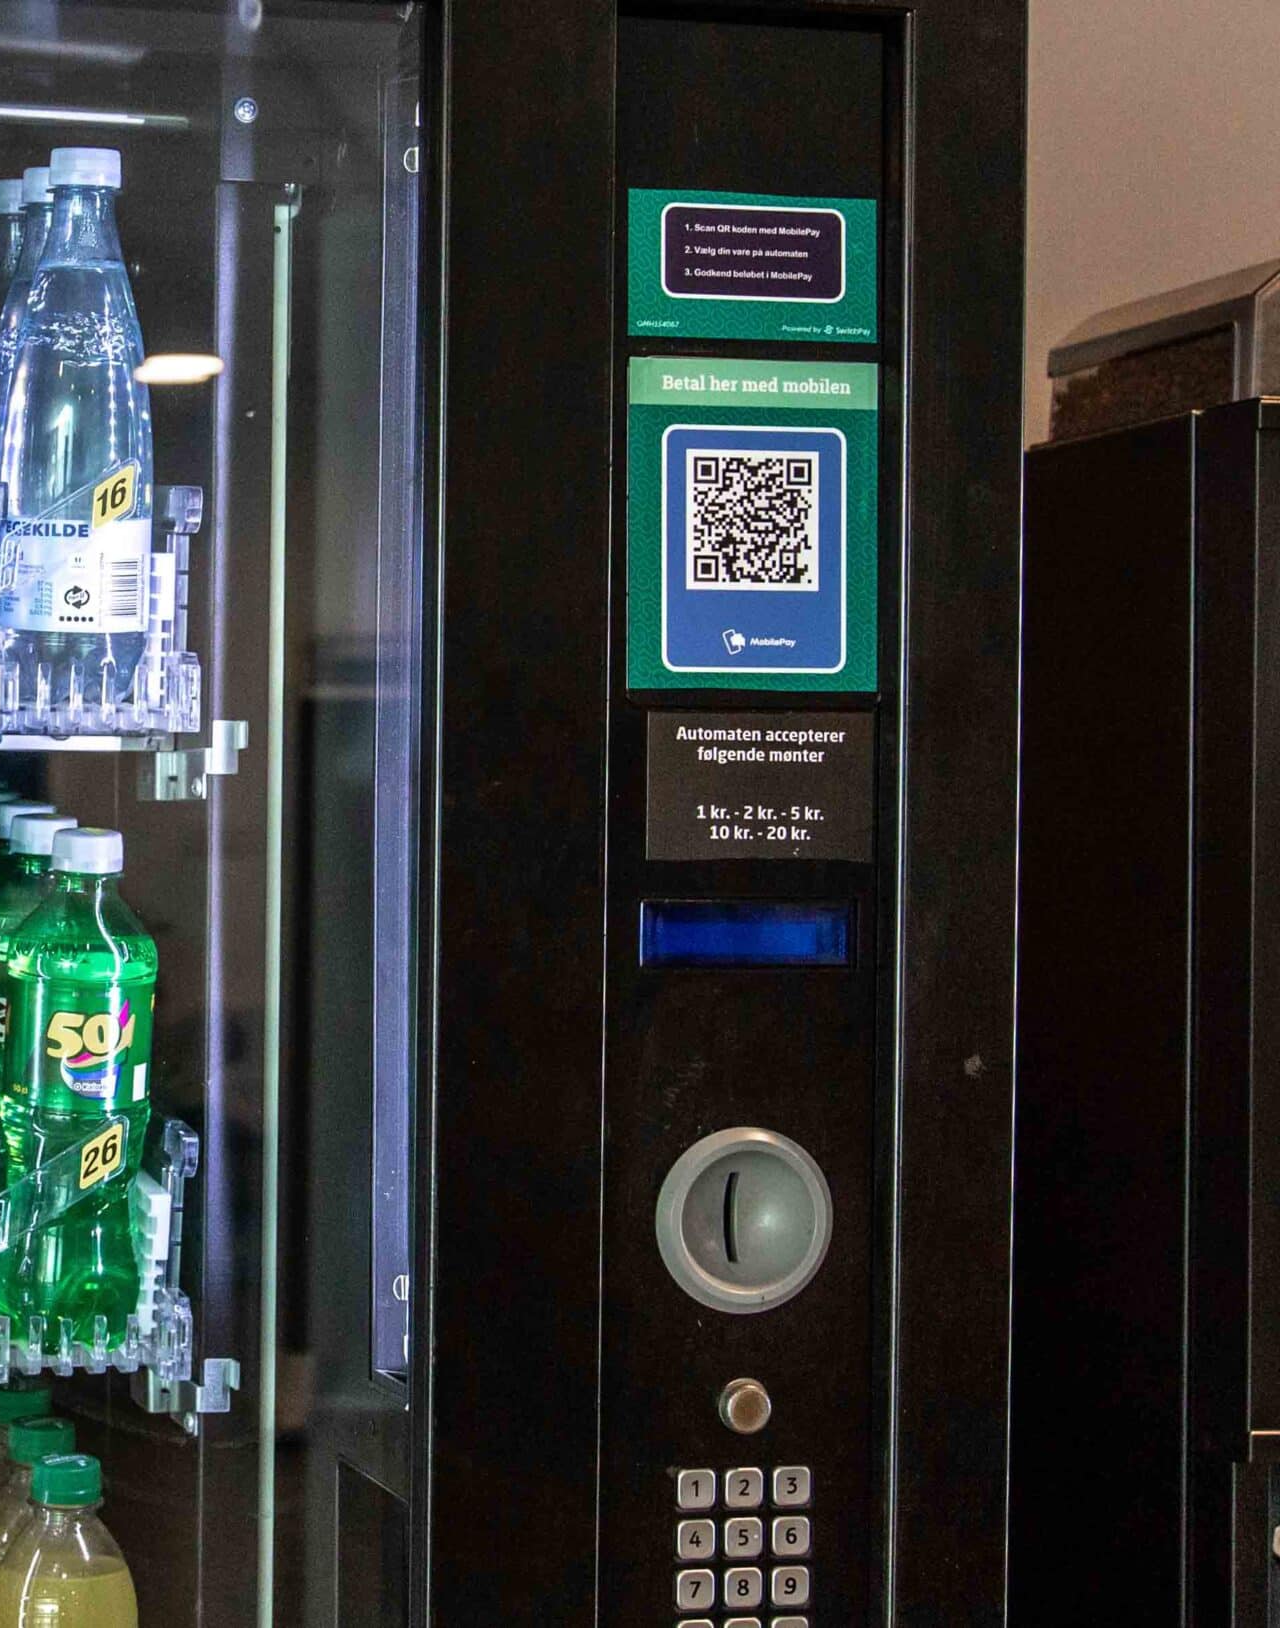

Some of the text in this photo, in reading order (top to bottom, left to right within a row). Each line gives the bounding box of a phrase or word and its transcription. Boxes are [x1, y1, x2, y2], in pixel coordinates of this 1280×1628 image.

[694, 224, 715, 233] Scan
[717, 225, 731, 234] QR
[732, 225, 757, 234] koden
[759, 226, 777, 235] med
[778, 227, 821, 238] MobilePay
[694, 246, 716, 256] Vælg
[717, 247, 731, 256] din
[732, 248, 751, 256] vare
[752, 247, 763, 258] på
[764, 249, 808, 258] automaten
[694, 269, 732, 278] Godkend
[733, 269, 765, 279] beløbet
[770, 271, 812, 282] MobilePay
[662, 374, 851, 395] Betal her med mobilen
[96, 477, 128, 517] 16
[749, 637, 797, 649] MobilePay
[676, 726, 846, 744] Automaten accepterer
[697, 746, 825, 764] følgende mønter
[696, 805, 706, 819] 1
[710, 805, 730, 820] kr.
[743, 806, 753, 819] 2
[757, 805, 777, 820] kr.
[791, 806, 800, 820] 5
[804, 806, 824, 820] kr.
[709, 825, 730, 840] 10
[733, 825, 754, 840] kr.
[767, 826, 787, 840] 20
[791, 826, 811, 841] kr.
[83, 1133, 118, 1181] 26
[691, 1480, 700, 1497] 1
[738, 1479, 750, 1497] 2
[786, 1477, 797, 1494] 3
[689, 1531, 702, 1548] 4
[738, 1529, 749, 1546] 5
[785, 1527, 797, 1545] 6
[689, 1581, 702, 1598] 7
[737, 1579, 749, 1596] 8
[783, 1577, 797, 1595] 9
